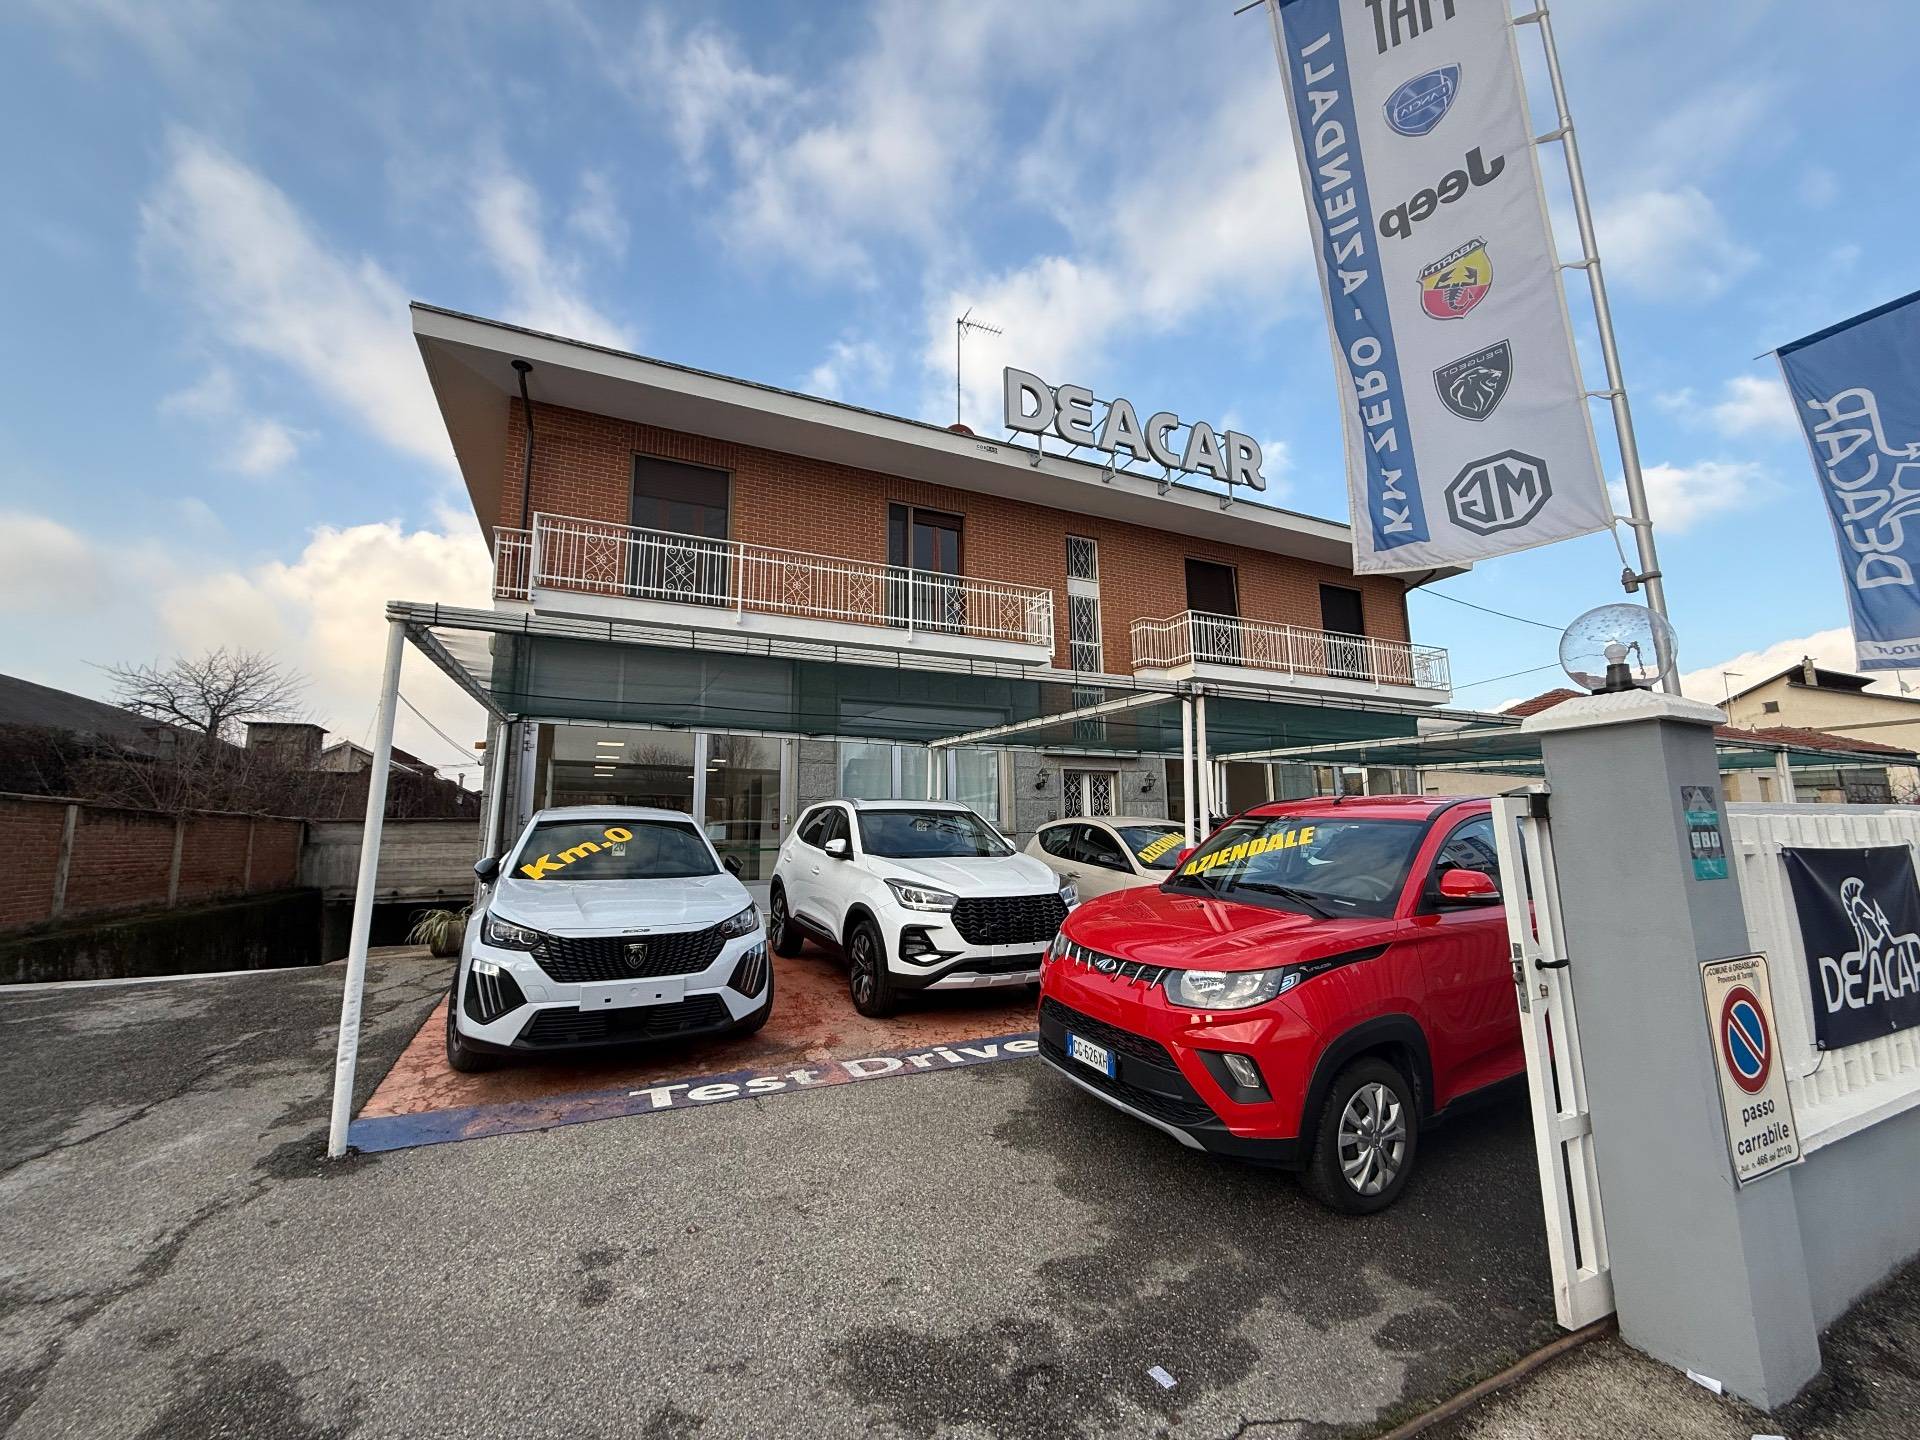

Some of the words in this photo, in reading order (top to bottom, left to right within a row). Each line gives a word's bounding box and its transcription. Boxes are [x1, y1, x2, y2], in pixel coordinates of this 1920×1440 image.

[1003, 366, 1266, 491] DEACAR
[1183, 826, 1316, 876] AZIENDALE
[1708, 965, 1728, 975] COMUNE
[630, 1067, 818, 1110] Test
[841, 1039, 1039, 1079] Drive
[1742, 1098, 1775, 1127] passo
[1737, 1122, 1790, 1155] carrabile
